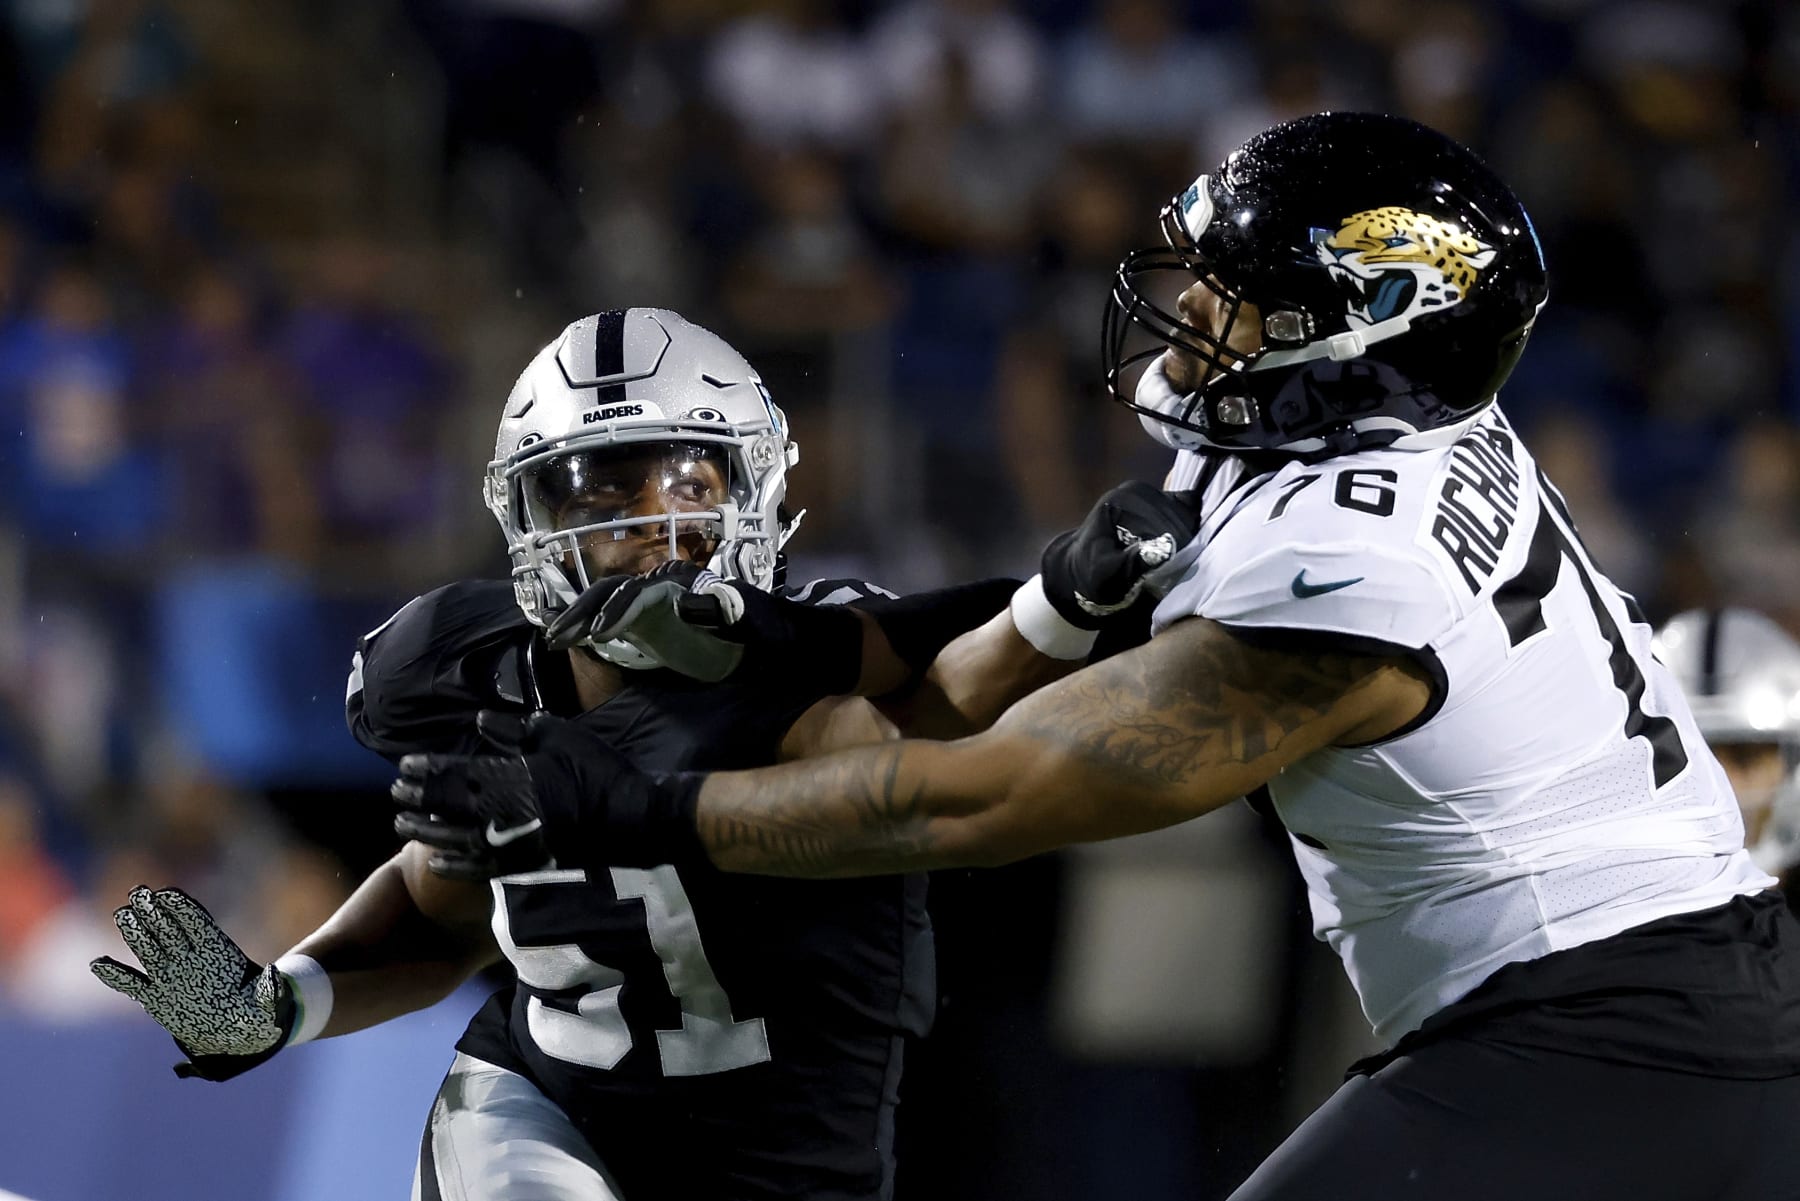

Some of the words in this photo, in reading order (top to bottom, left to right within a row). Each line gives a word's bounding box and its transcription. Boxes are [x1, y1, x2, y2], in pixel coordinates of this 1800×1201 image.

[583, 404, 643, 424] RAIDERS
[1268, 469, 1398, 517] 76
[1491, 466, 1690, 792] 7
[490, 864, 771, 1077] 51
